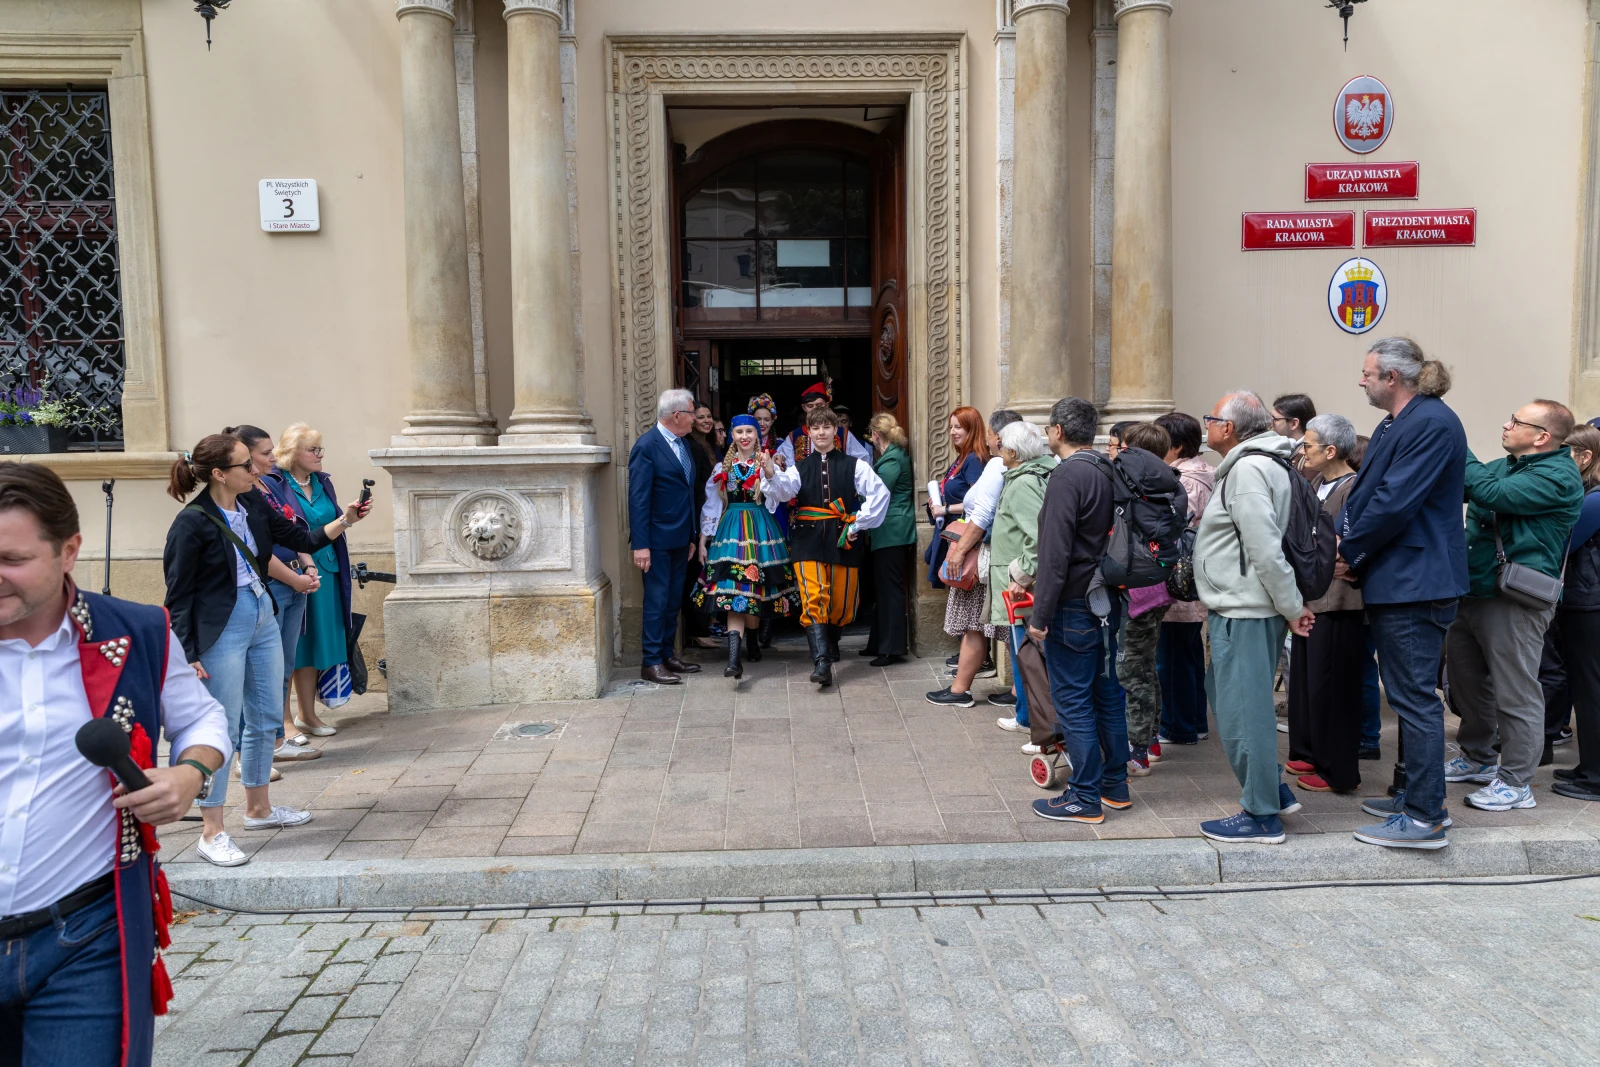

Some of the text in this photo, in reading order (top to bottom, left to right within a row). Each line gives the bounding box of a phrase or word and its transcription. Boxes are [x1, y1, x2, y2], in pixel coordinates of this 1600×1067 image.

[1326, 169, 1401, 181] URZĄD MIASTA
[275, 181, 308, 189] Wszystkich
[1338, 182, 1388, 192] KRAKOWA
[274, 188, 302, 197] Świętych
[282, 198, 294, 218] 3
[1266, 218, 1334, 228] RADA MIASTA
[1372, 216, 1470, 226] PREZYDENT MIASTA
[1275, 232, 1325, 242] KRAKOWA
[1396, 230, 1446, 240] KRAKOWA
